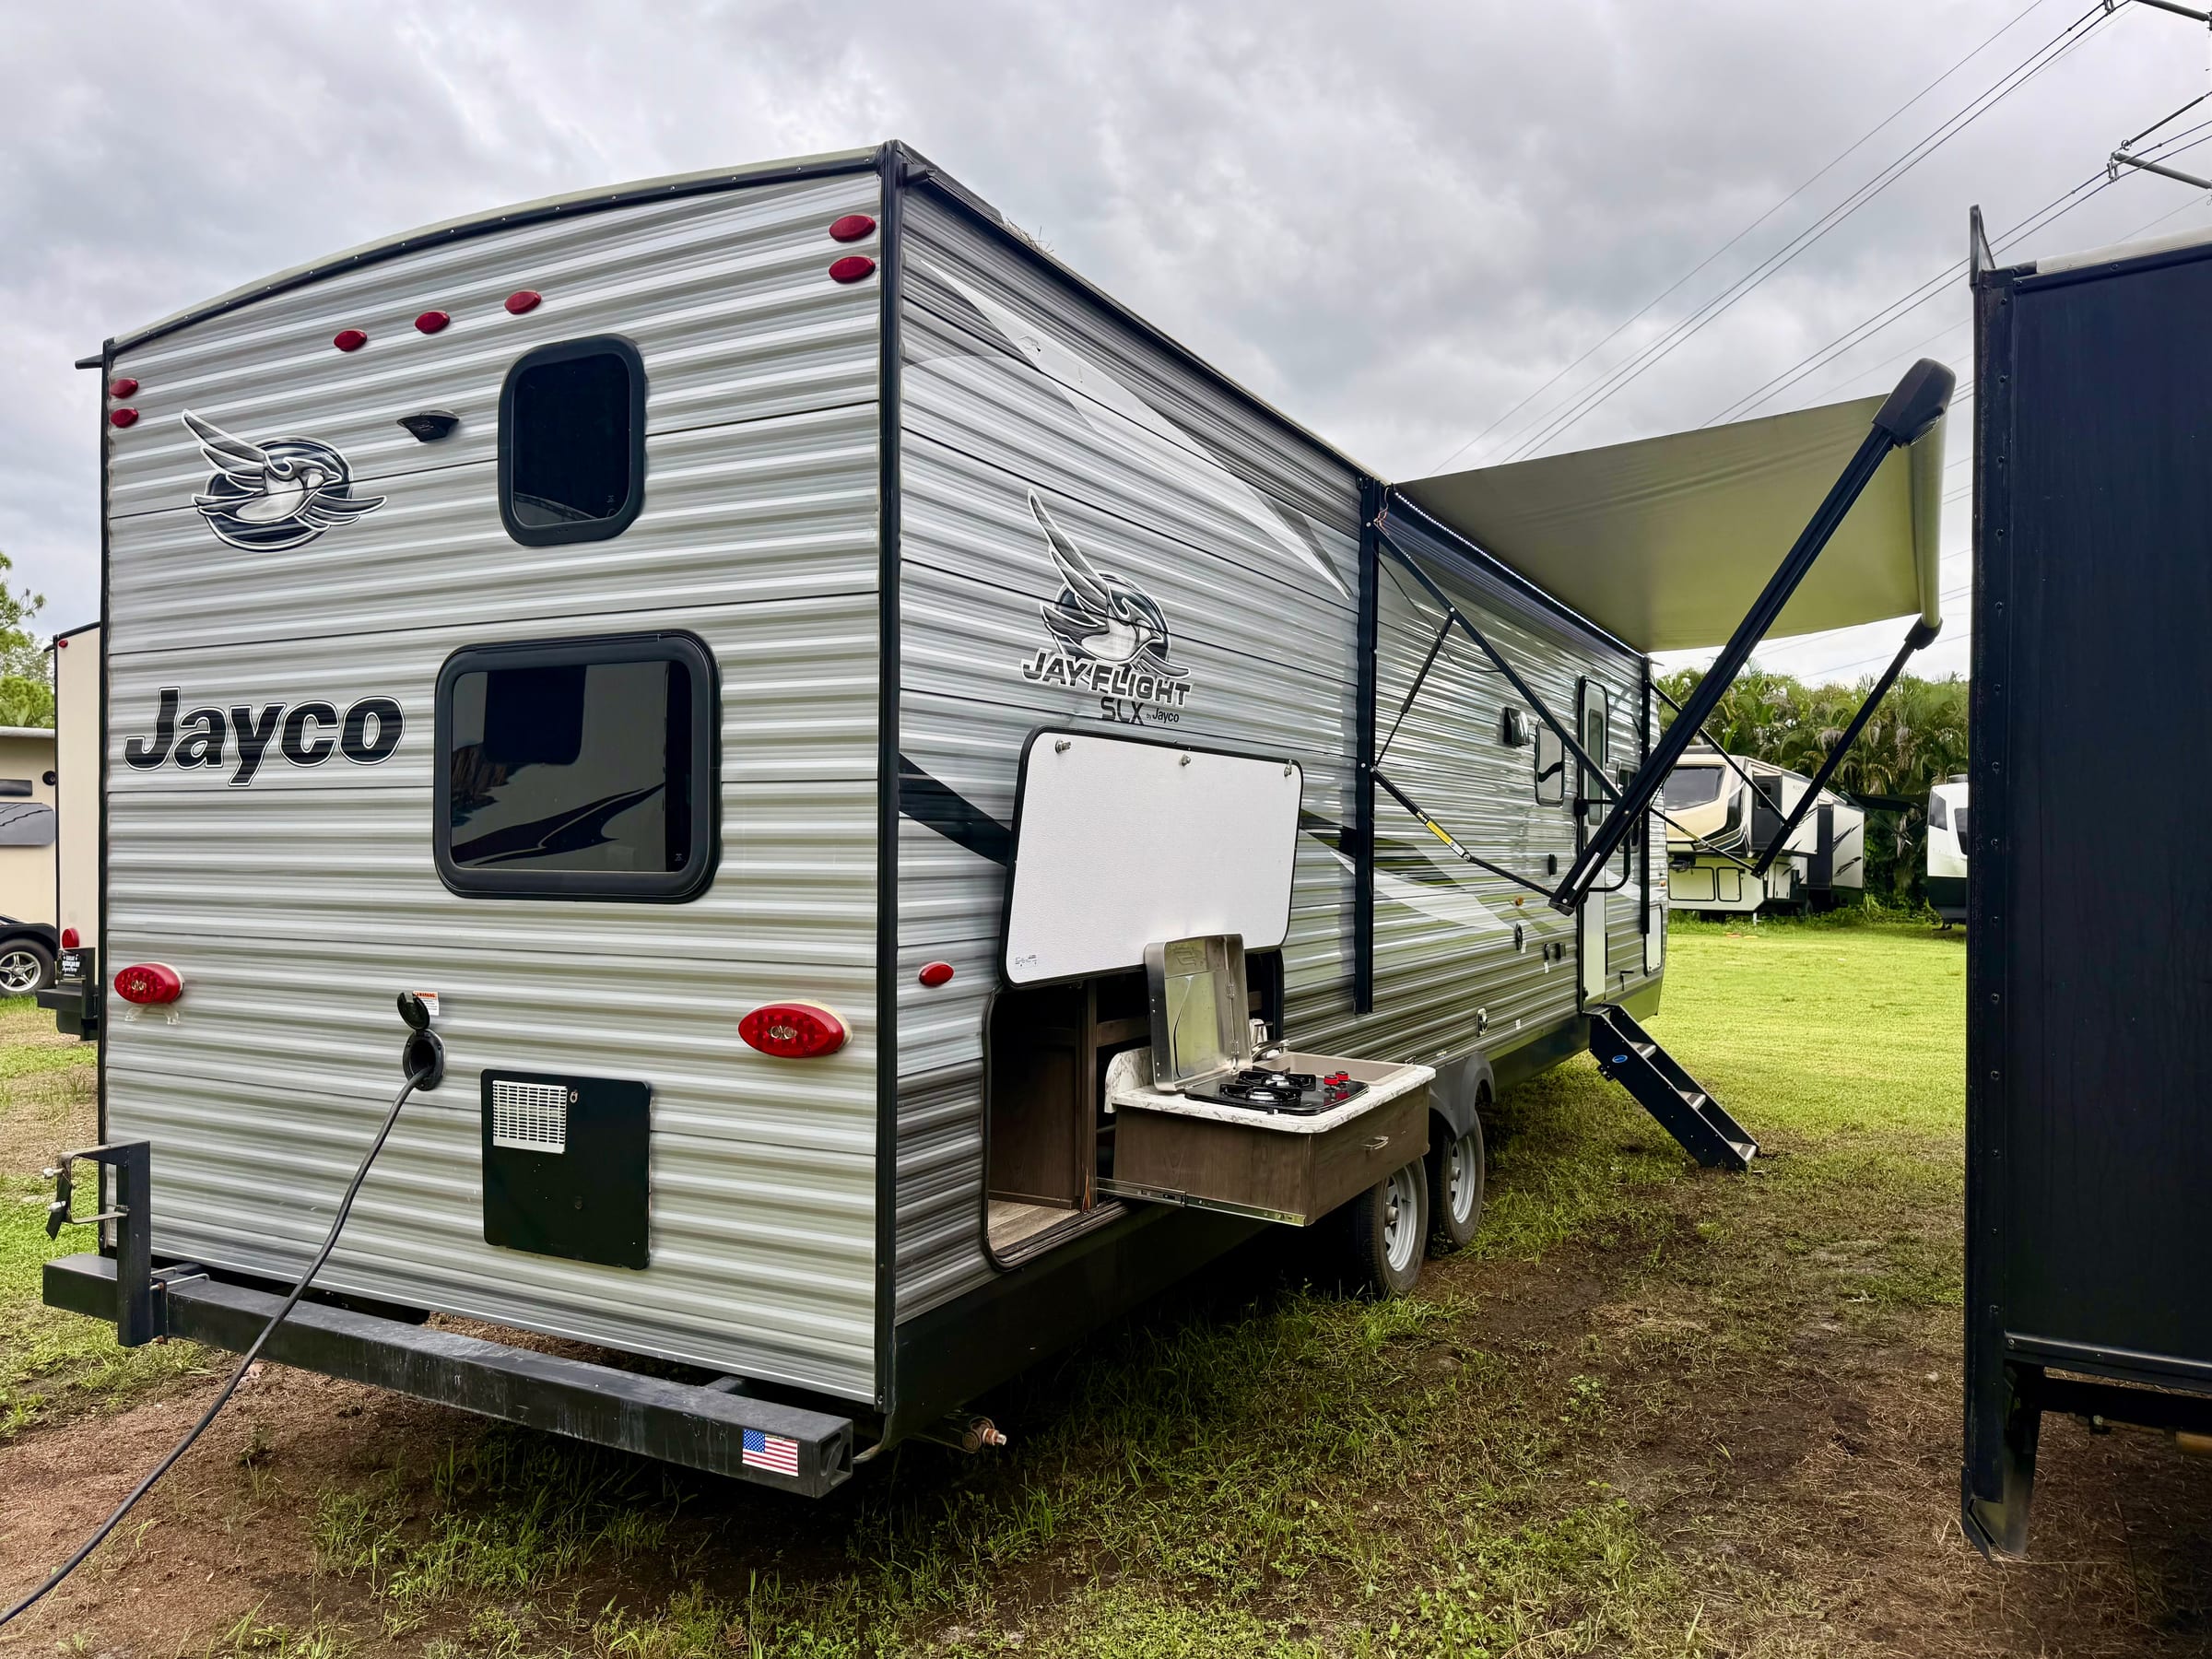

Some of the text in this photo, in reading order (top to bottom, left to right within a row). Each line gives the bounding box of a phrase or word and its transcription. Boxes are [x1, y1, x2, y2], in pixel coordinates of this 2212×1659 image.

[1021, 651, 1191, 706] JAY FLIGHT
[1100, 696, 1144, 725] SLX
[1152, 707, 1180, 724] Jayco
[123, 686, 406, 787] Jayco
